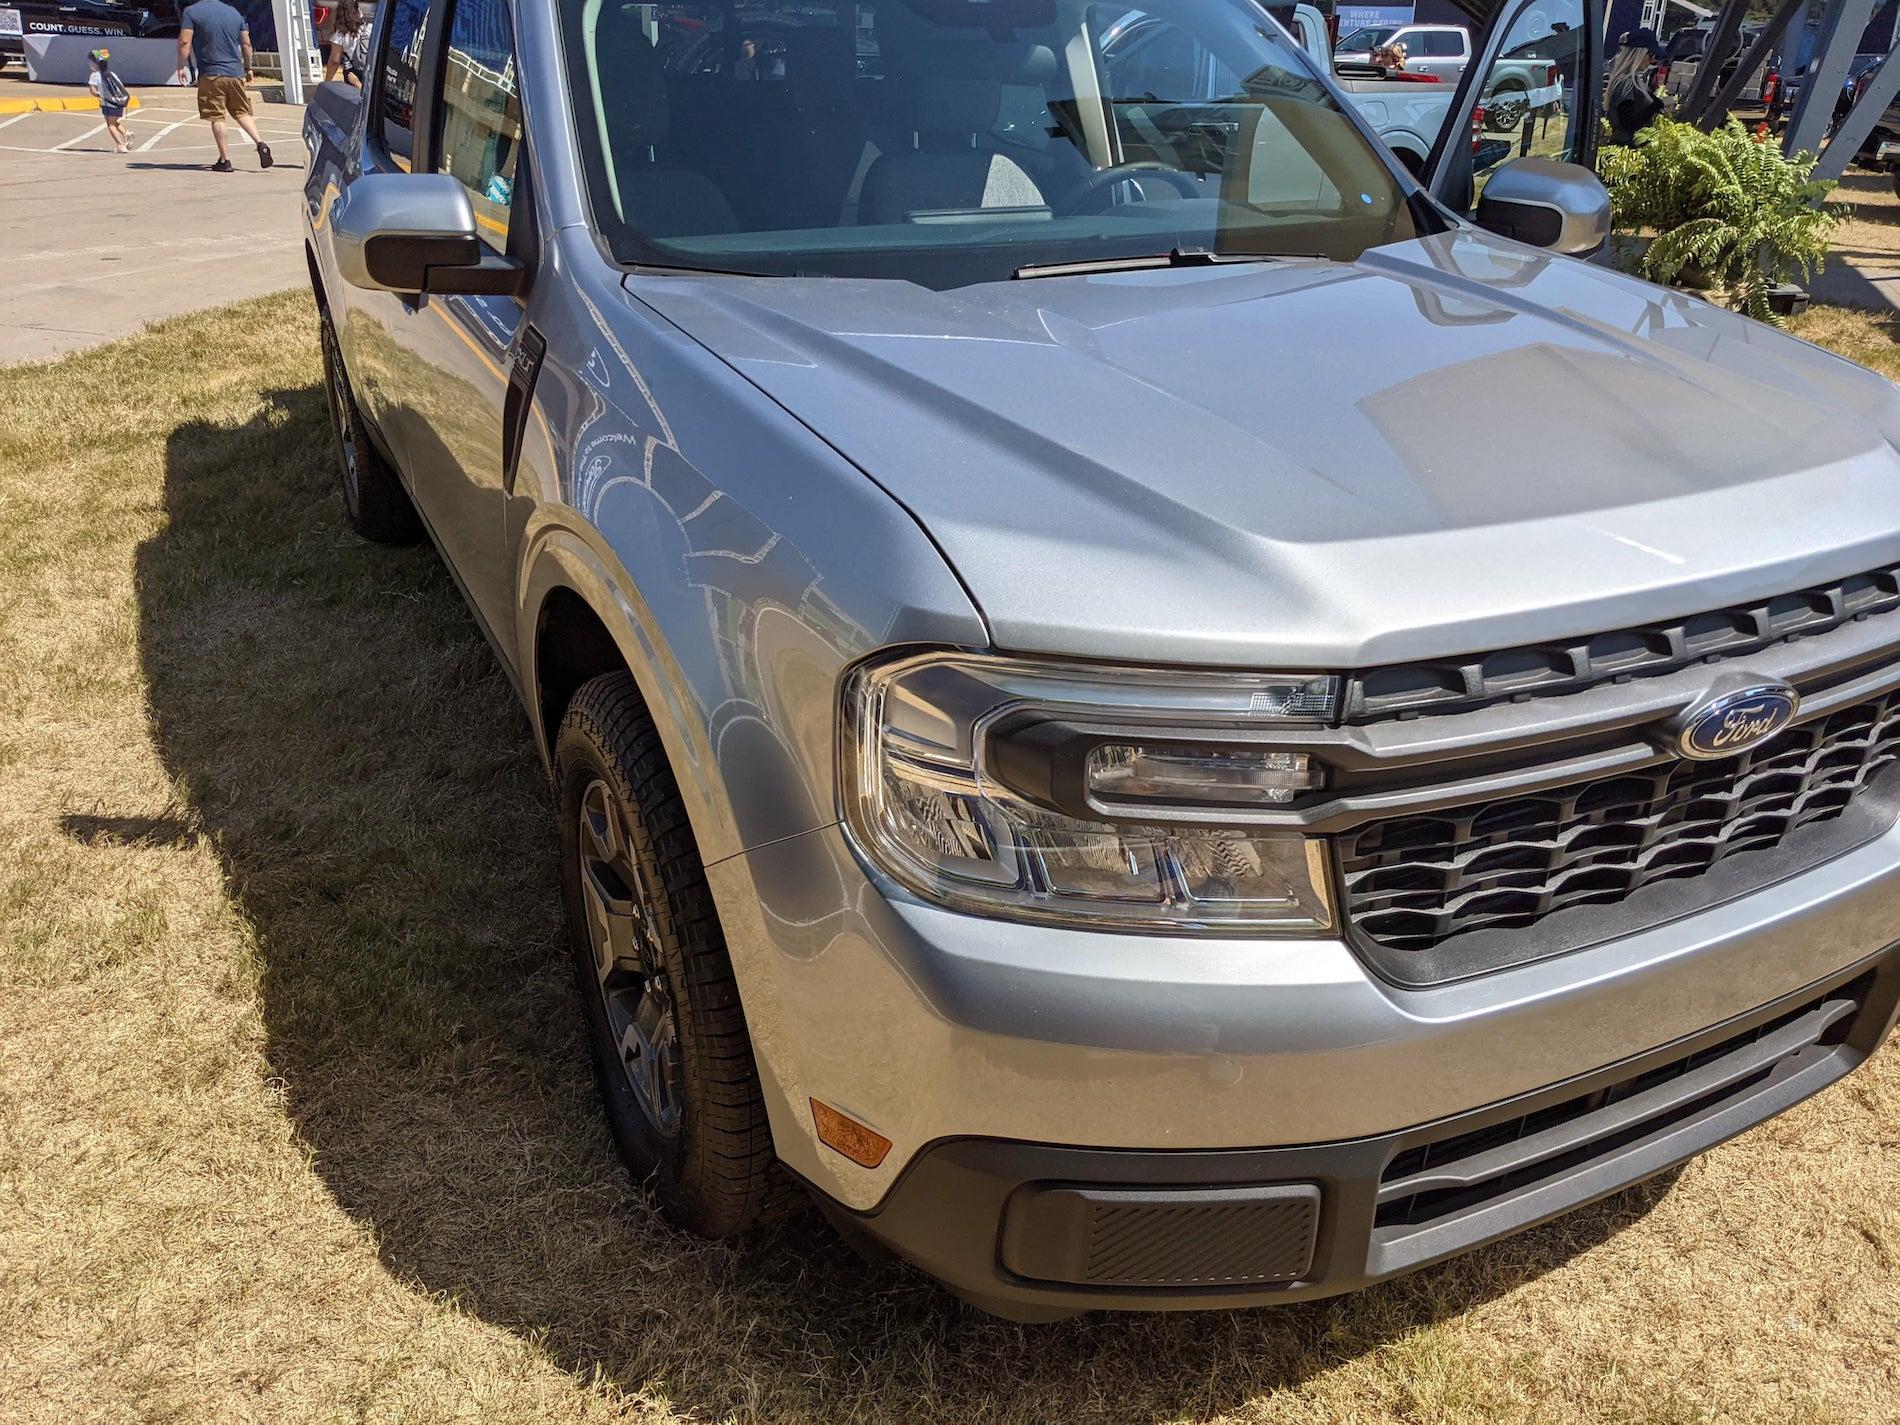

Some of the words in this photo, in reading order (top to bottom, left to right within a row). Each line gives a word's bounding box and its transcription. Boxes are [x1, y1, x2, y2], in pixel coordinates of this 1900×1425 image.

[1350, 10, 1380, 19] WHERE
[29, 22, 67, 32] COUNT.
[68, 25, 103, 35] GUESS.
[104, 27, 126, 37] WIN.
[1712, 703, 1777, 747] Ford
